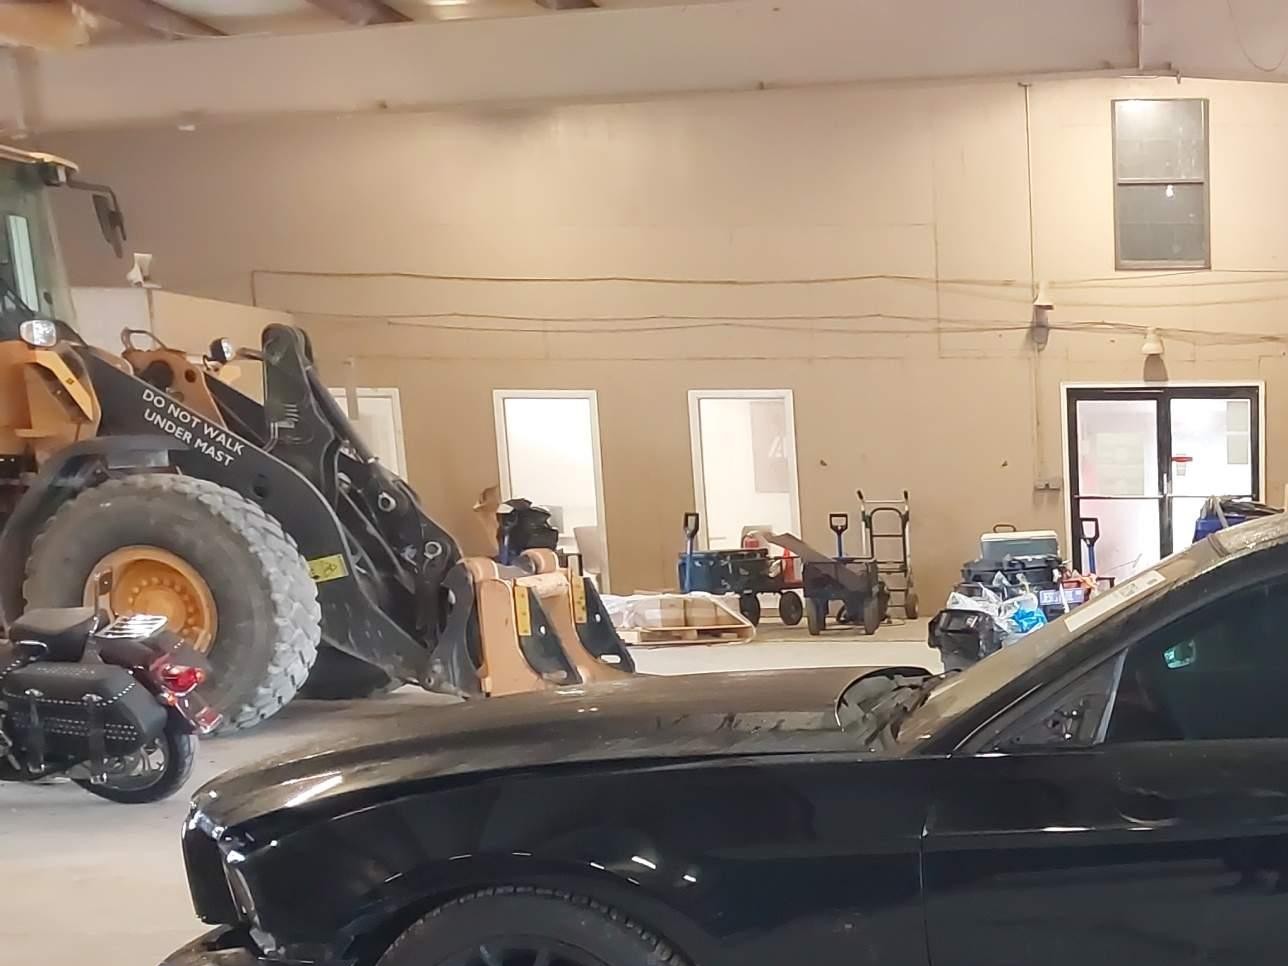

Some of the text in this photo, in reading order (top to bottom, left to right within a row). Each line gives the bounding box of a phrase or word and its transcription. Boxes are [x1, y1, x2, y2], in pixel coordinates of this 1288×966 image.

[142, 388, 245, 456] DO NOT WALK
[143, 408, 234, 467] UNDER MAST
